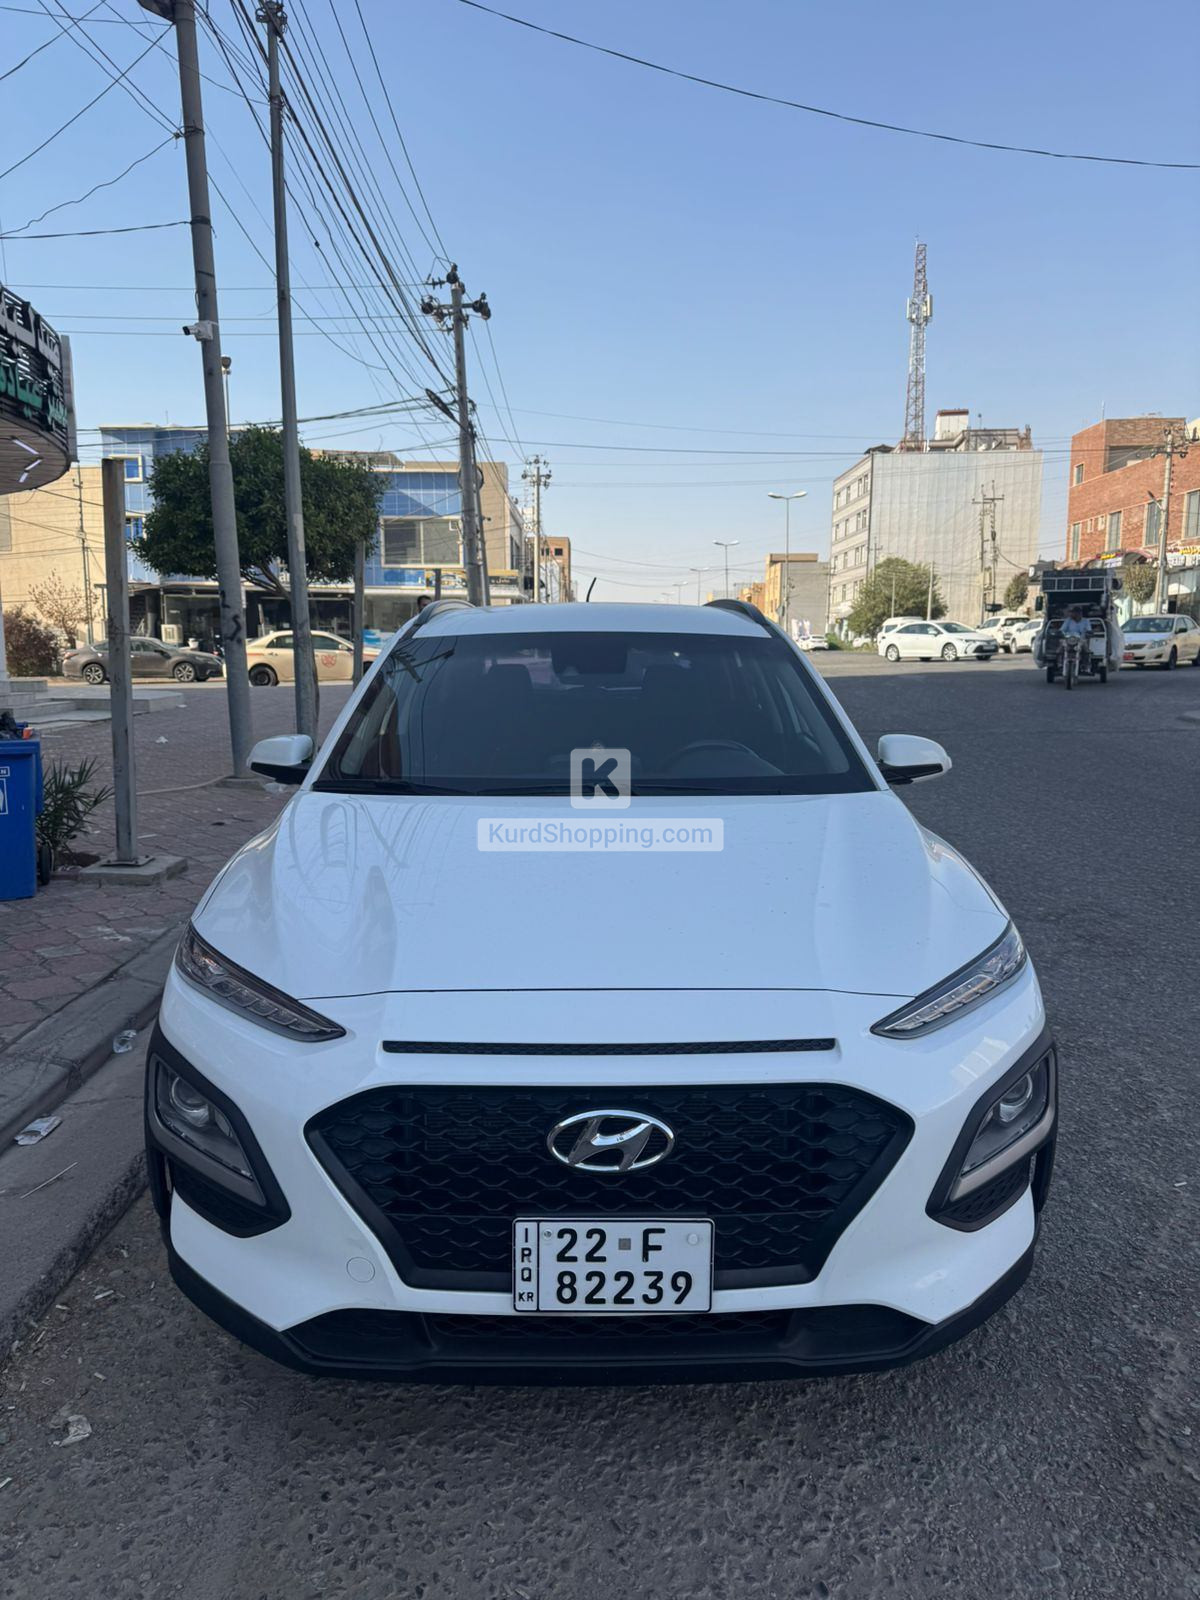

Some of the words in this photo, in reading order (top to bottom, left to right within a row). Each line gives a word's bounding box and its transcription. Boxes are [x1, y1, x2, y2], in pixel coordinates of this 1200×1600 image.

[556, 1228, 607, 1263] 22
[642, 1228, 666, 1263] F
[518, 1291, 534, 1302] KR
[556, 1270, 693, 1305] 82239
